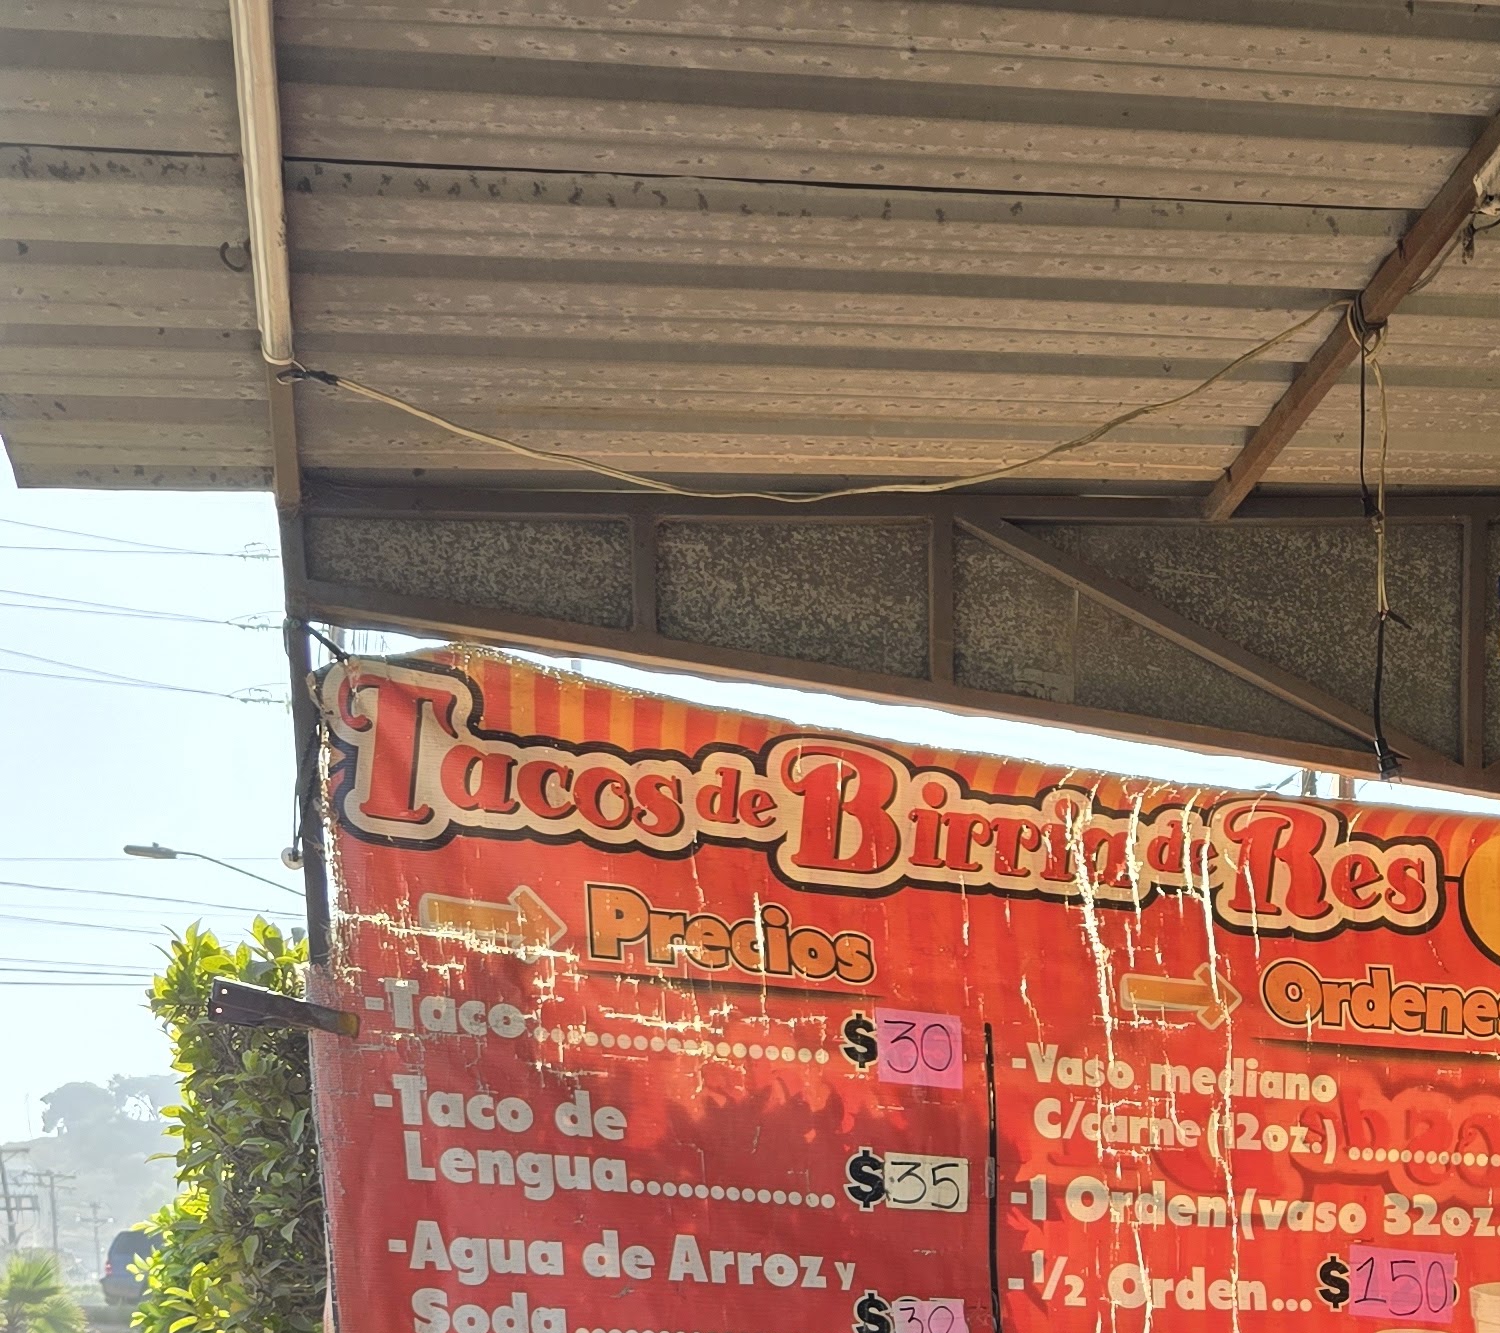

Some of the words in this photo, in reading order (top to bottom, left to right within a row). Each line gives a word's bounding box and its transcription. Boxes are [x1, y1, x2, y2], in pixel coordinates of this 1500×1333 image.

[338, 674, 686, 838] Tacos
[695, 766, 780, 829] de
[780, 745, 1137, 889] Birria
[1146, 819, 1218, 877] de
[1223, 806, 1431, 919] Res
[585, 881, 876, 985] Precios
[1150, 1057, 1338, 1103] mediano
[554, 1089, 628, 1141] de
[1033, 1097, 1202, 1149] C/carne
[1065, 1173, 1228, 1232] Orden
[1241, 1187, 1367, 1242] (vaso
[581, 1229, 655, 1281] de
[667, 1233, 829, 1290] Arroz
[833, 1260, 857, 1291] y
